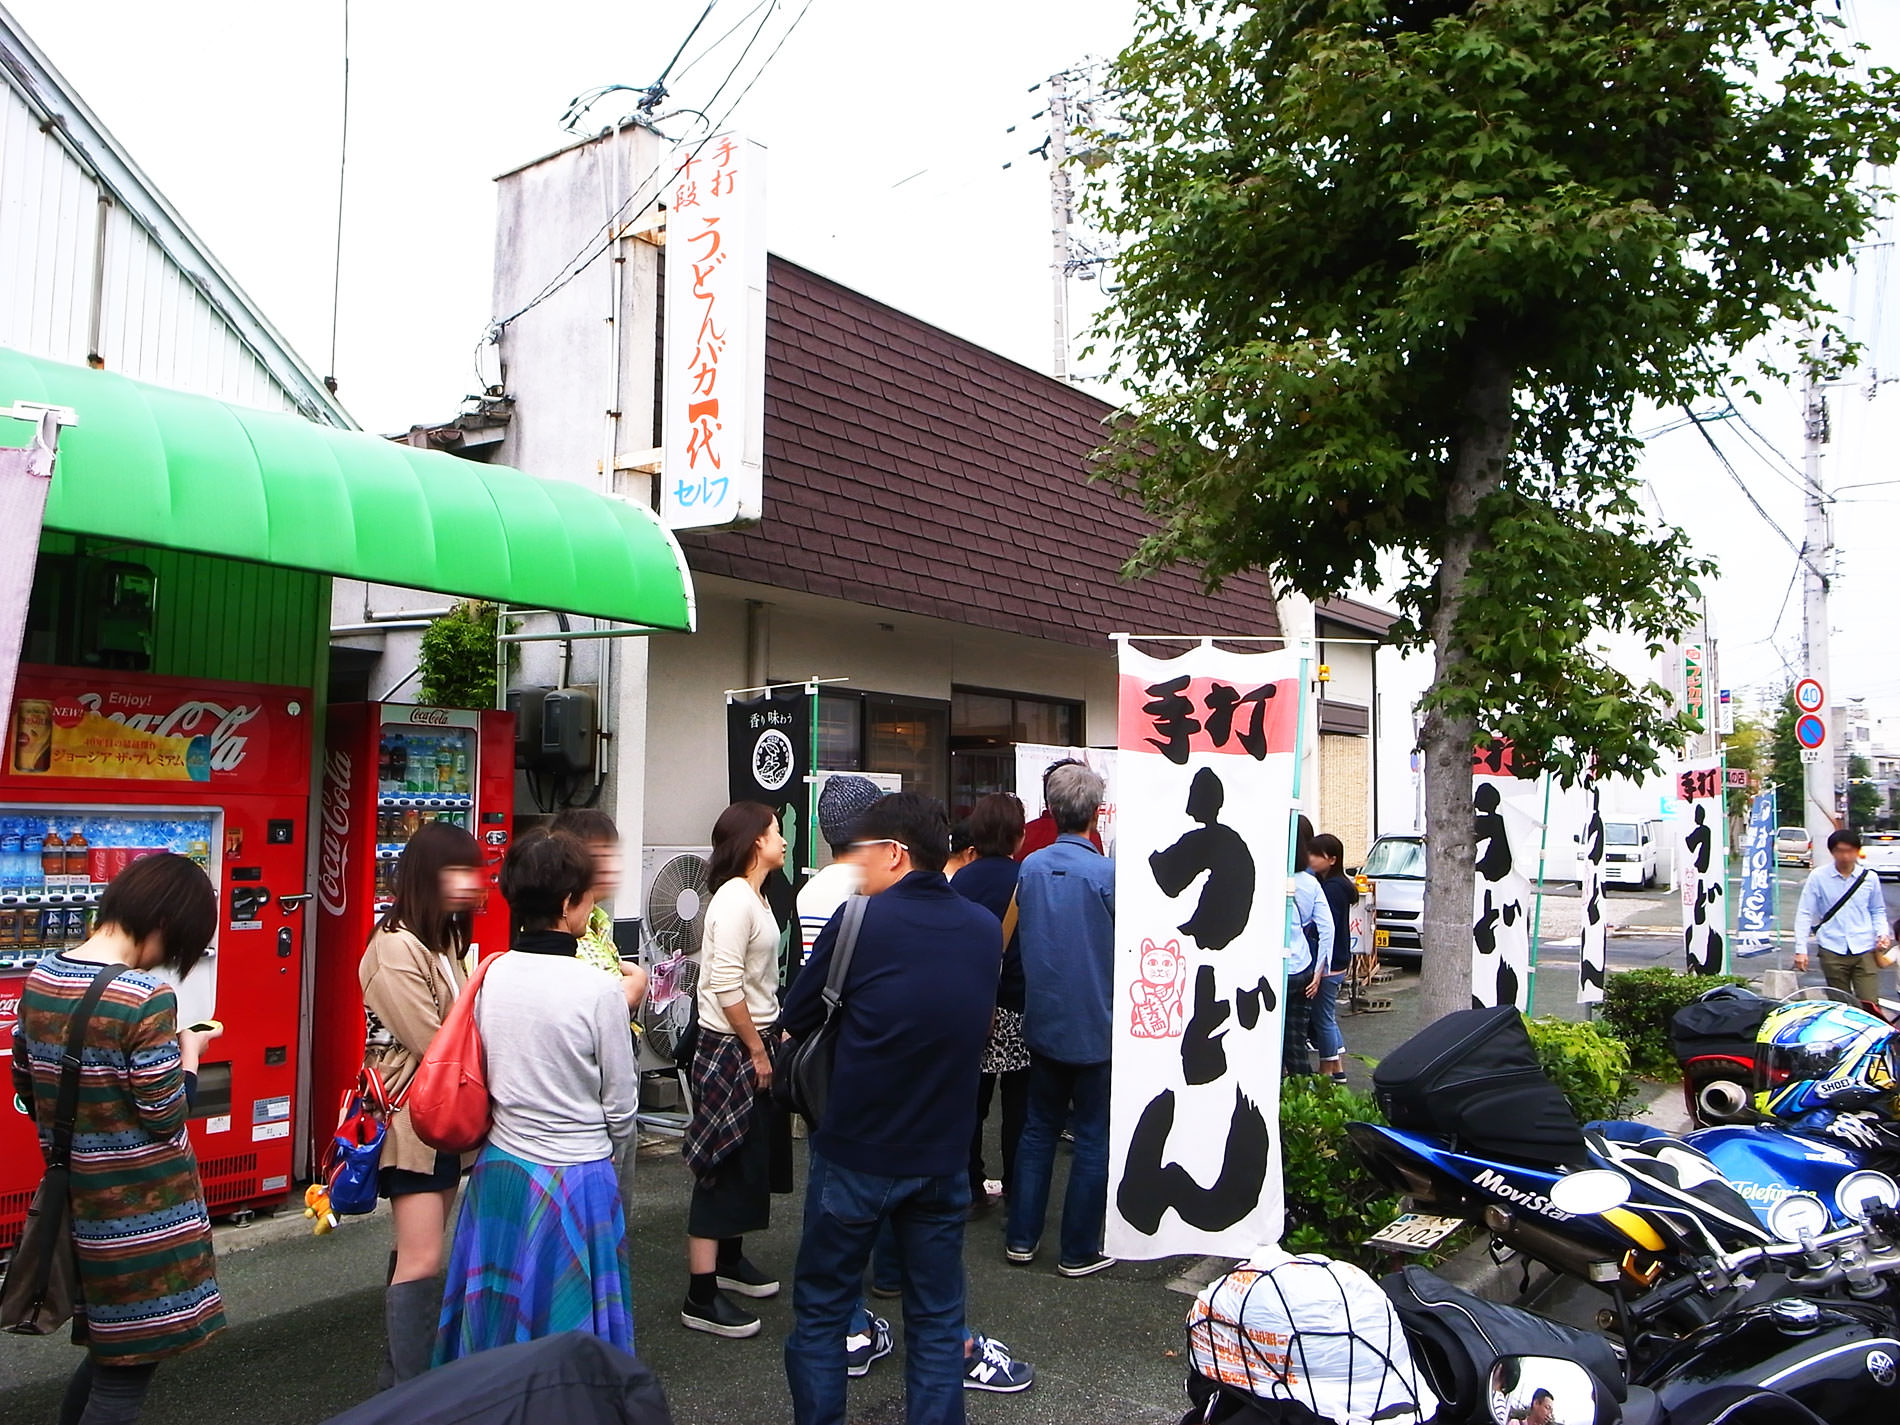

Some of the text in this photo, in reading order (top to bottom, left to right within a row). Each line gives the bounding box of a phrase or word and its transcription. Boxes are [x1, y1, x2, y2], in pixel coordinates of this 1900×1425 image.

[673, 151, 703, 212] 十段
[711, 136, 739, 196] 手打
[687, 217, 727, 470] うどんバカ一代
[673, 477, 730, 508] セルフ
[53, 707, 84, 718] NEW!
[109, 691, 152, 708] Enjoy!
[1802, 688, 1818, 703] 40
[78, 693, 262, 771] Cca-Cla
[1142, 675, 1277, 765] 手打
[53, 747, 113, 763] ジョージア
[1680, 769, 1717, 804] 手打
[318, 749, 352, 917] Coca-Cola
[1685, 804, 1723, 976] うどん
[1117, 767, 1277, 1237] うどん
[1821, 1078, 1850, 1093] SHOEI
[1472, 1168, 1577, 1222] MoviStar
[1377, 1224, 1443, 1245] 51-02
[969, 1361, 997, 1384] N
